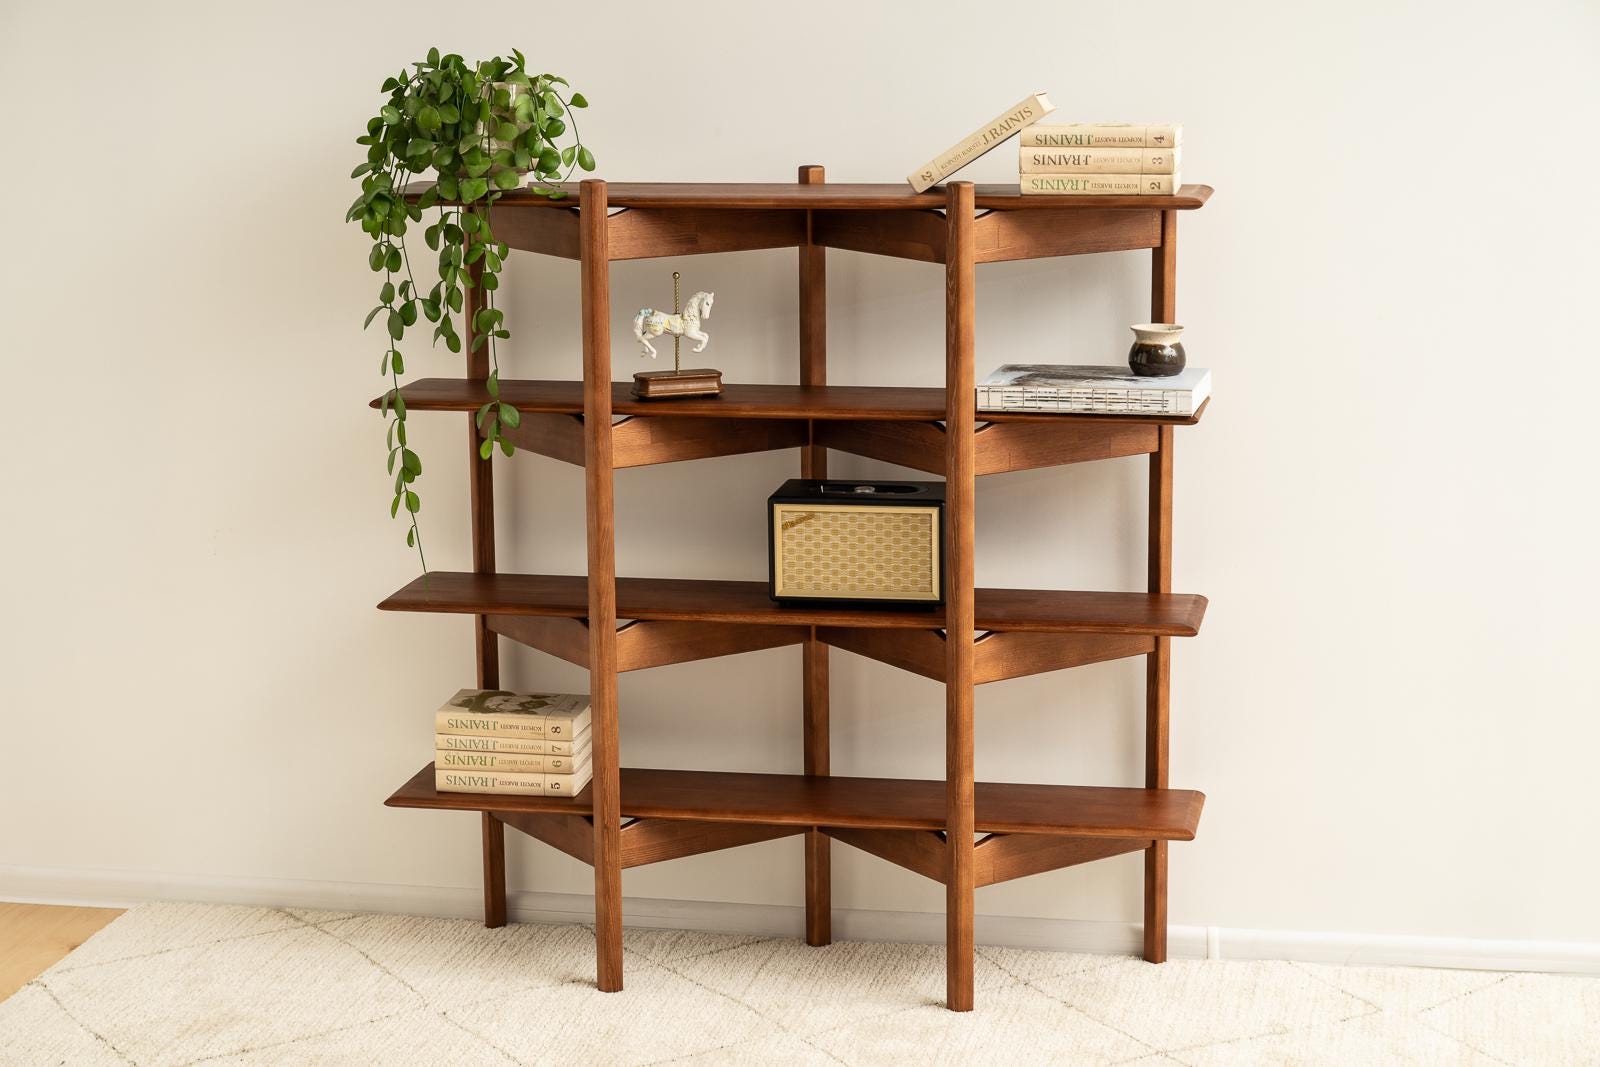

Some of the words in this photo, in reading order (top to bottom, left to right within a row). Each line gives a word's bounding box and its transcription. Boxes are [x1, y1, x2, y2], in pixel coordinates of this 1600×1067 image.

[1152, 157, 1163, 165] 3
[1150, 182, 1161, 190] 2
[551, 726, 561, 734] 8
[552, 760, 562, 768] 6
[551, 782, 561, 790] 5
